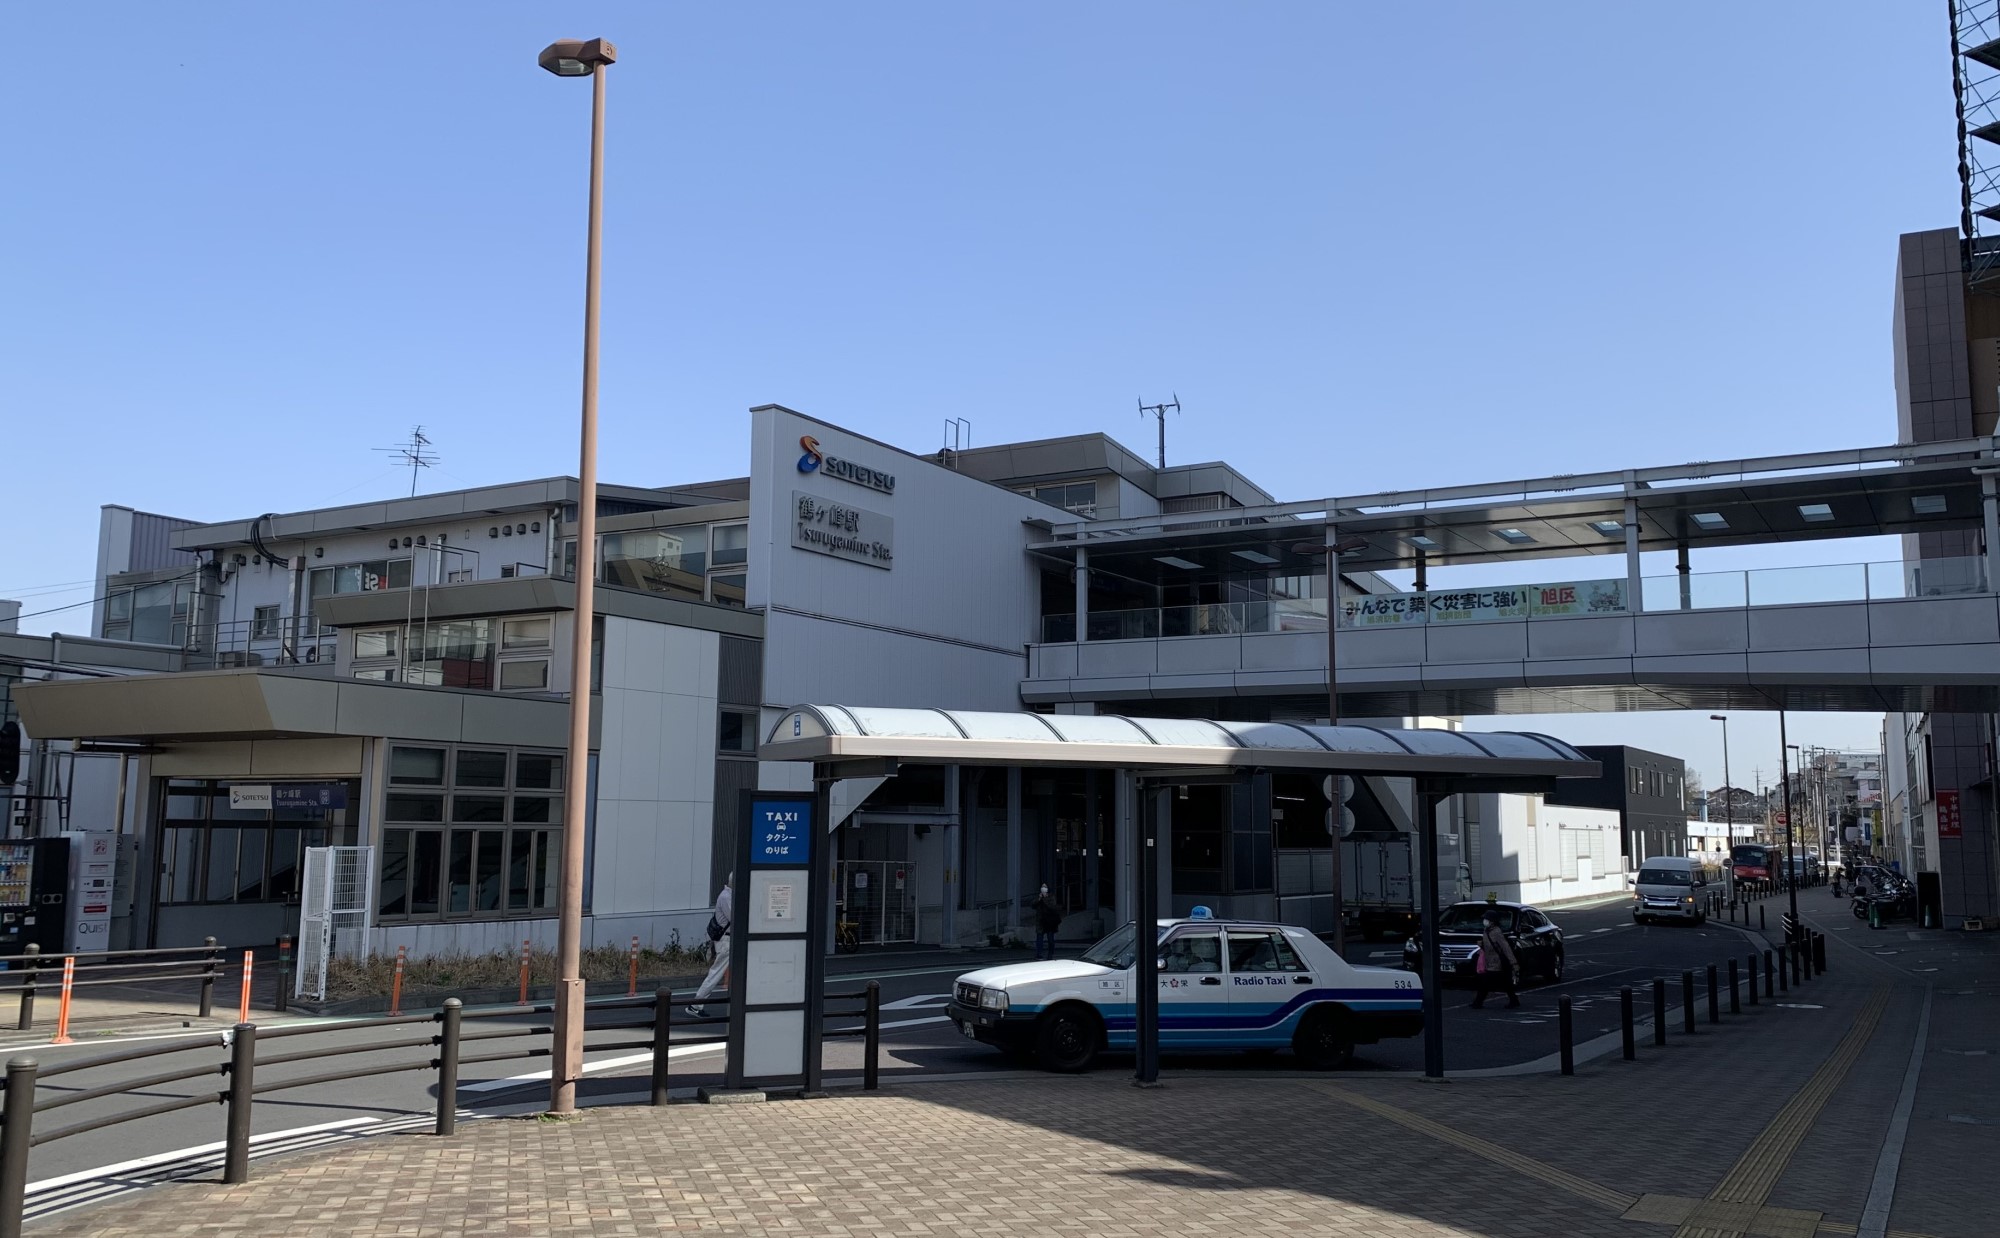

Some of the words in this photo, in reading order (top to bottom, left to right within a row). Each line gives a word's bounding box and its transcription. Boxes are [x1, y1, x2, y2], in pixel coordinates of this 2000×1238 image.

[826, 456, 895, 490] SOTETSU
[797, 522, 870, 556] Tsurugamine
[872, 541, 893, 560] Sta.
[765, 812, 798, 821] TAXI
[766, 833, 797, 842] タクシー
[765, 846, 789, 855] のりば
[1234, 976, 1264, 986] Radio
[1265, 976, 1286, 985] Taxi
[1394, 980, 1412, 989] 534
